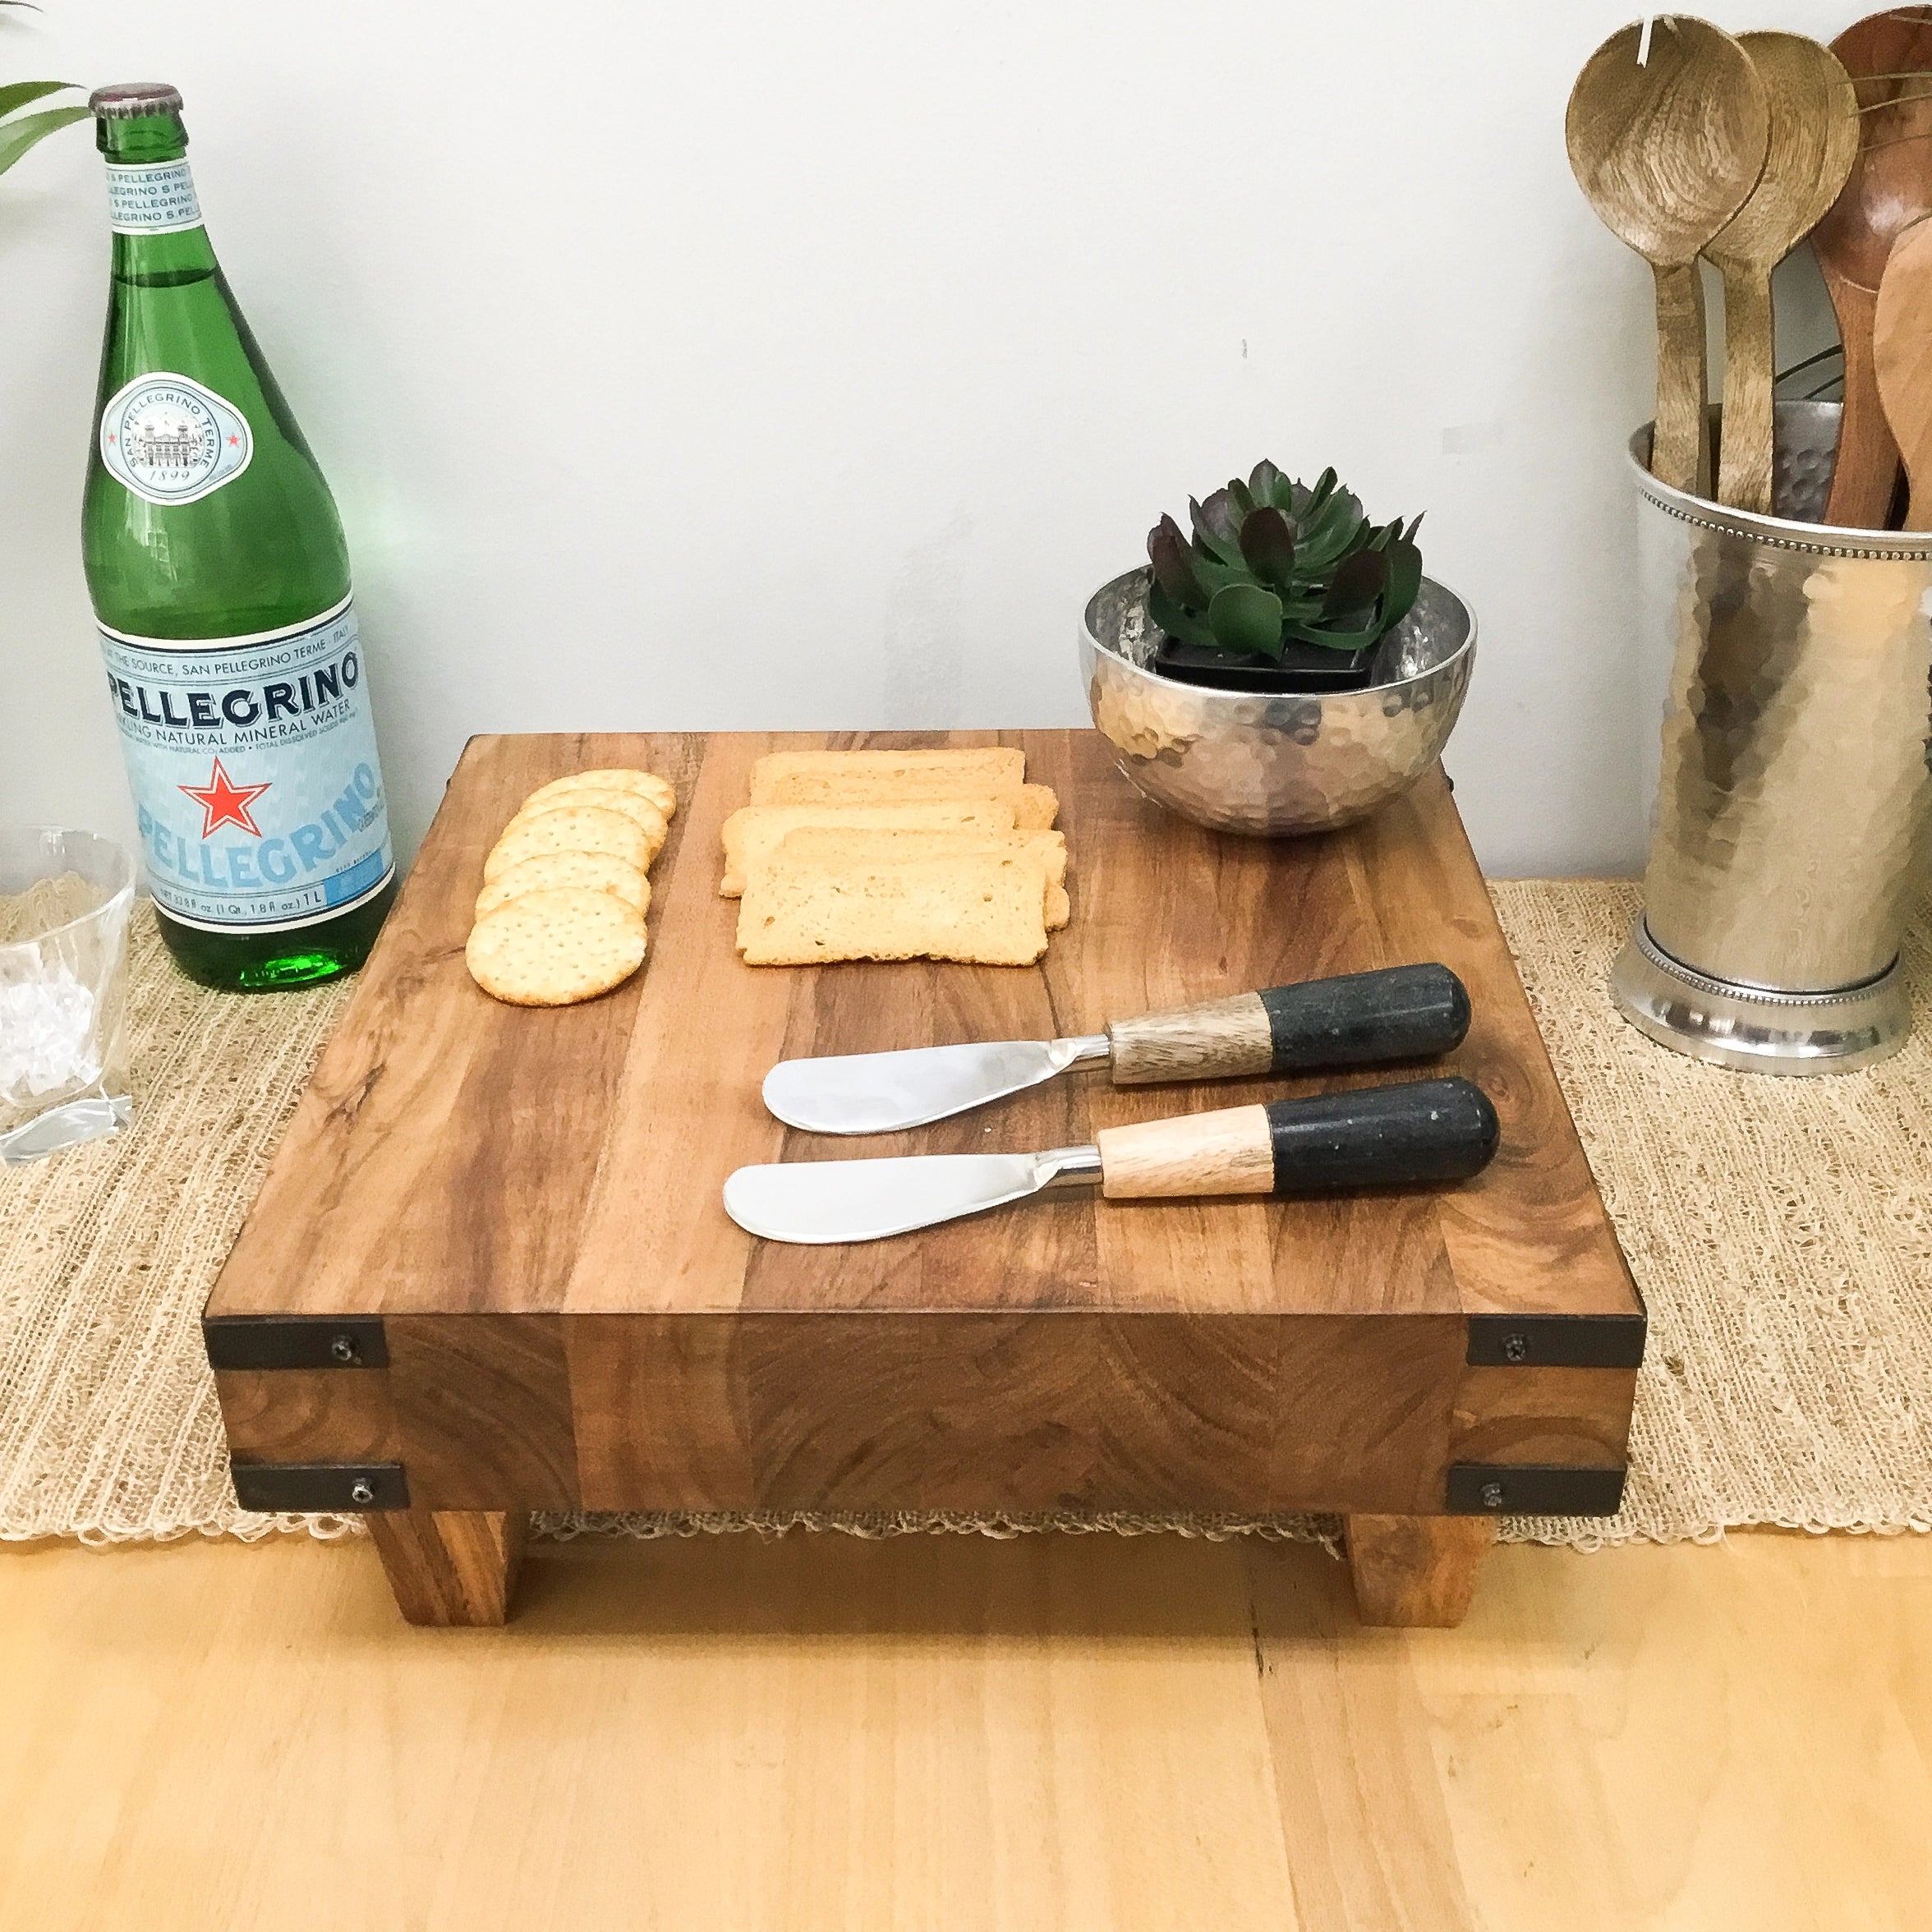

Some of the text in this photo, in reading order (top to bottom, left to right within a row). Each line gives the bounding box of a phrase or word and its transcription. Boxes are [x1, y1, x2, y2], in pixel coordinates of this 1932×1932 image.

[118, 168, 186, 184] PELLEGRINO
[122, 193, 193, 209] PELLEGRINO
[123, 393, 215, 469] SAN PELLEGRINO TERME
[149, 469, 191, 482] 1899
[131, 658, 178, 677] SOURCE,
[182, 664, 211, 675] SAN
[214, 652, 292, 675] PELLEGRINO
[293, 638, 327, 660] TERME
[107, 651, 360, 729] PELLEGRINO
[155, 729, 228, 746] NATURAL
[234, 720, 307, 744] MINERAL
[310, 698, 351, 726] WATER
[218, 746, 246, 754] ADDED
[255, 740, 278, 751] TOTAL
[280, 729, 318, 746] DISSOLVED
[138, 761, 375, 888] PELLEGRINO
